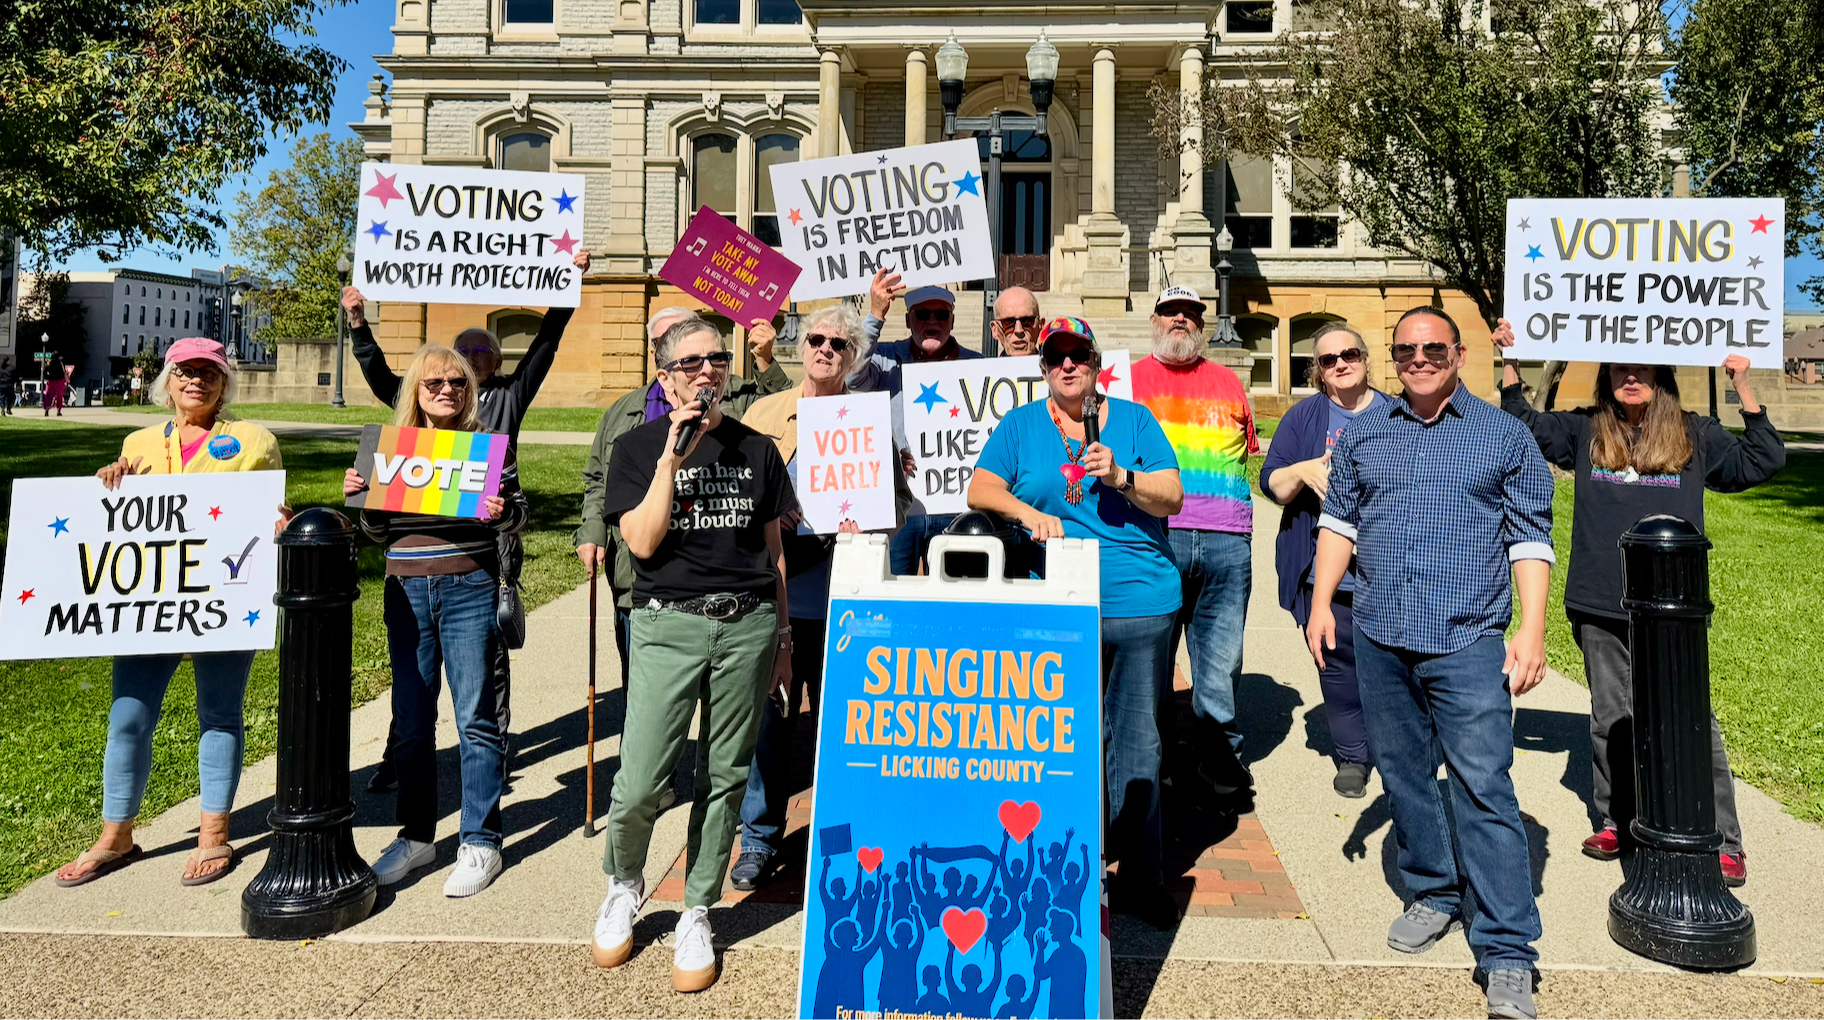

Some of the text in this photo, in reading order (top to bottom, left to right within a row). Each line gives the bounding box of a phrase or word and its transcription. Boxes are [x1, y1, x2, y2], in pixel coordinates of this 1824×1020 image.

[406, 183, 545, 222] VOTING
[801, 161, 950, 219] VOTING
[395, 228, 554, 257] IS A RIGHT
[802, 204, 964, 251] IS FREEDOM
[1550, 216, 1734, 263] VOTING
[711, 250, 759, 287] VOTE AWAY
[722, 240, 760, 271] TAKE MY
[817, 237, 962, 282] IN ACTION
[364, 260, 572, 291] WORTH PROTECTING
[693, 275, 744, 313] NOT TODAY!
[1523, 272, 1771, 311] IS THE POWER
[1526, 312, 1771, 348] OF THE PEOPLE
[958, 376, 1046, 423] VOT
[813, 426, 875, 458] VOTE
[919, 428, 981, 461] LIKE
[373, 452, 490, 493] VOTE
[675, 479, 740, 496] is loud
[714, 461, 754, 480] hate
[809, 460, 882, 494] EARLY
[100, 494, 195, 533] YOUR
[693, 510, 752, 530] louder
[708, 496, 755, 512] must
[78, 538, 213, 597] VOTE
[44, 599, 229, 637] MATTERS
[863, 646, 1065, 701] SINGING
[844, 699, 1075, 753] RESISTANCE
[881, 754, 1045, 783] LICKING COUNTY
[836, 1005, 853, 1020] For
